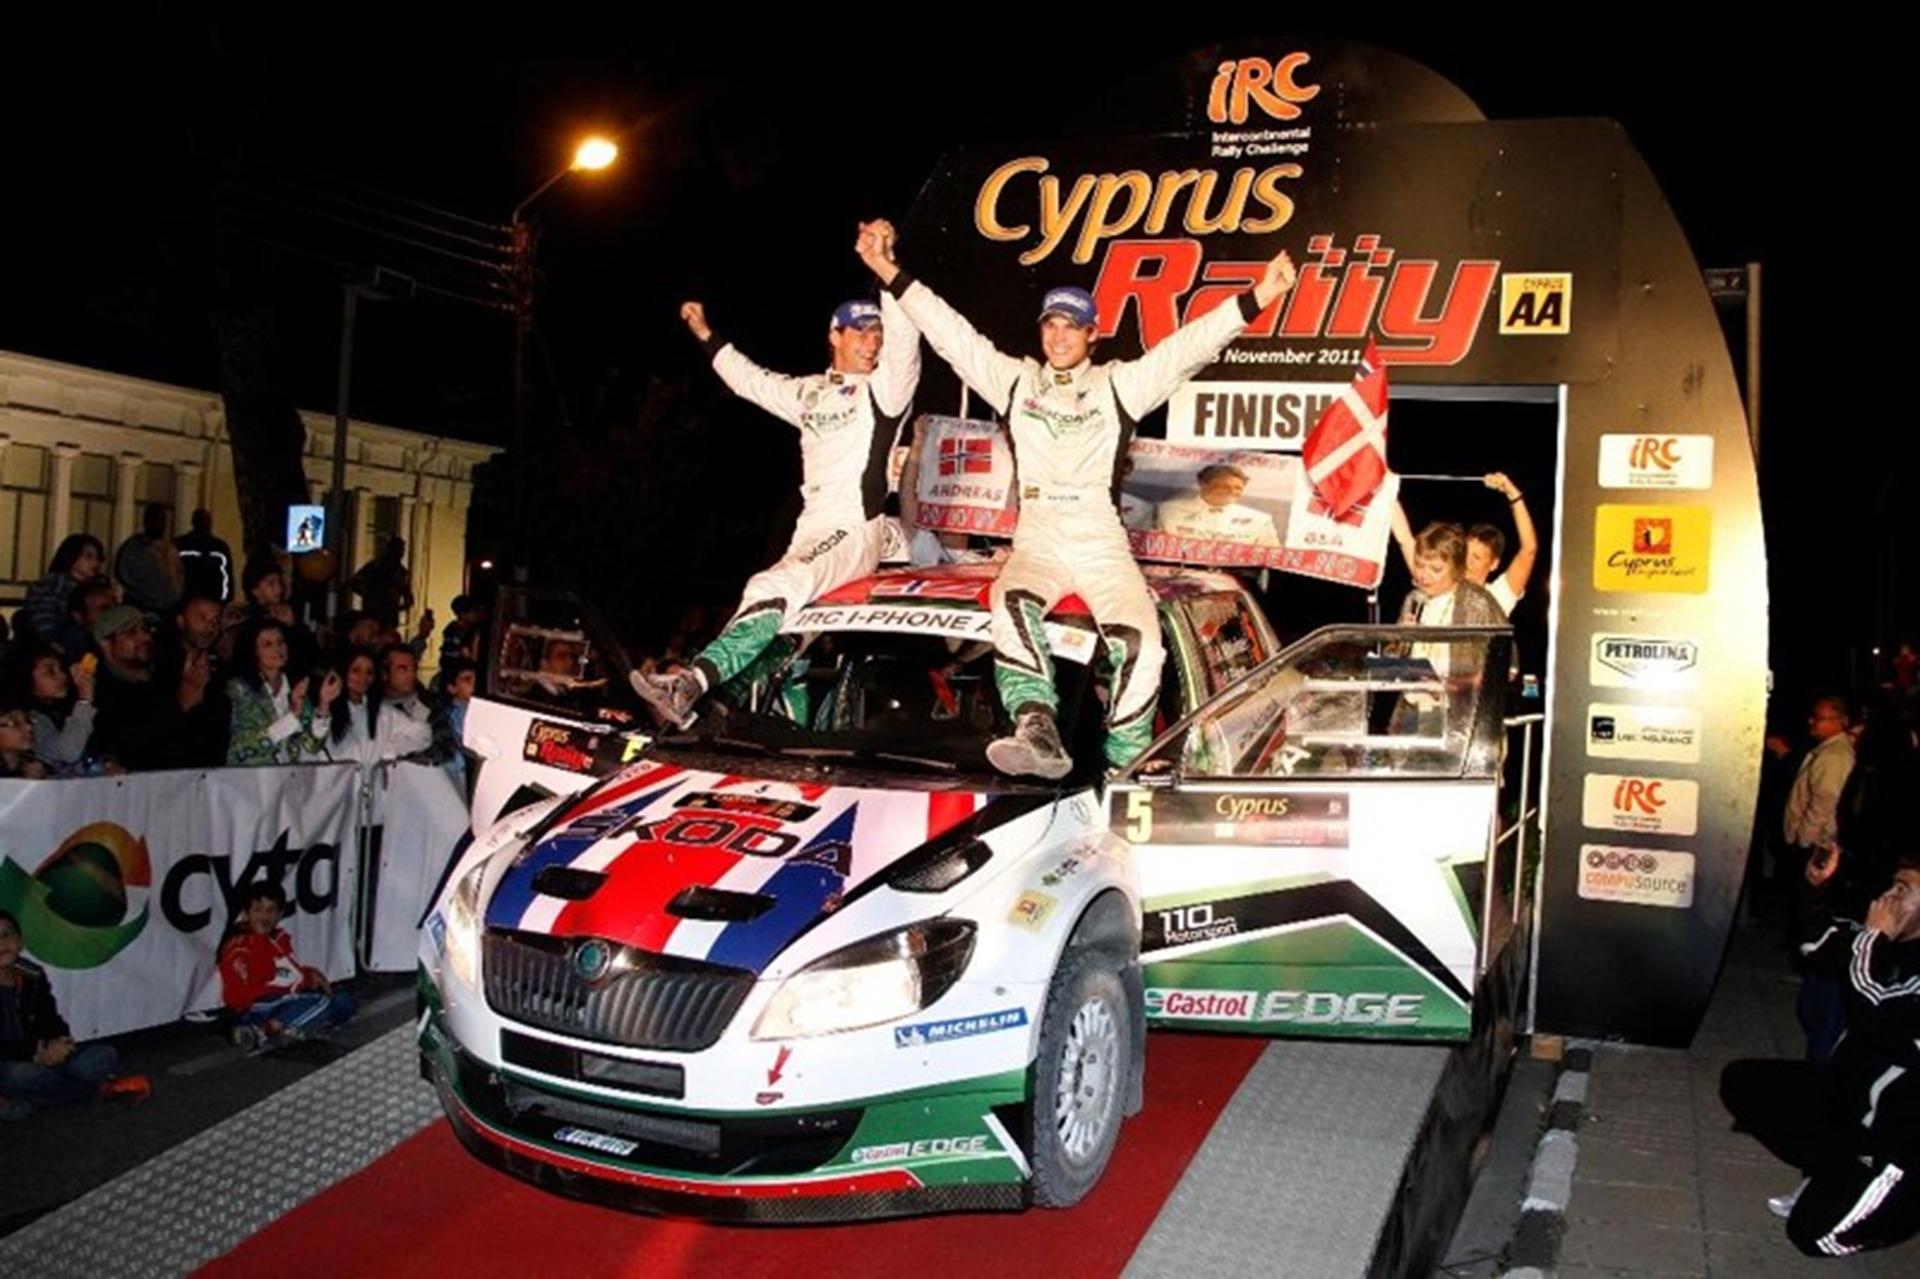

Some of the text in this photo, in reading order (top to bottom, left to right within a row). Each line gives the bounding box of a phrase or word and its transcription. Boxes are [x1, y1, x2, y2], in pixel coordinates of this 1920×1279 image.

[1212, 127, 1311, 143] Intercontinental
[1211, 143, 1309, 159] Rally Challenge
[975, 157, 1302, 265] Cyprus
[1090, 235, 1500, 366] Rally
[1506, 291, 1563, 327] AA
[1224, 349, 1314, 364] November
[1317, 349, 1361, 365] 2011
[928, 484, 1003, 501] ANDREAS
[1607, 550, 1676, 576] Cyprus
[796, 611, 839, 627] IRC
[849, 609, 973, 631] I-PHONE
[1605, 642, 1689, 661] PETROLINA
[1126, 792, 1154, 843] 5
[1215, 793, 1289, 820] Cyprus
[1159, 904, 1213, 931] 110
[1164, 922, 1238, 945] Motorsport
[1166, 991, 1425, 1025] Castrol EDGE
[928, 1011, 1021, 1038] MICHELIN
[911, 1135, 989, 1155] EDGE
